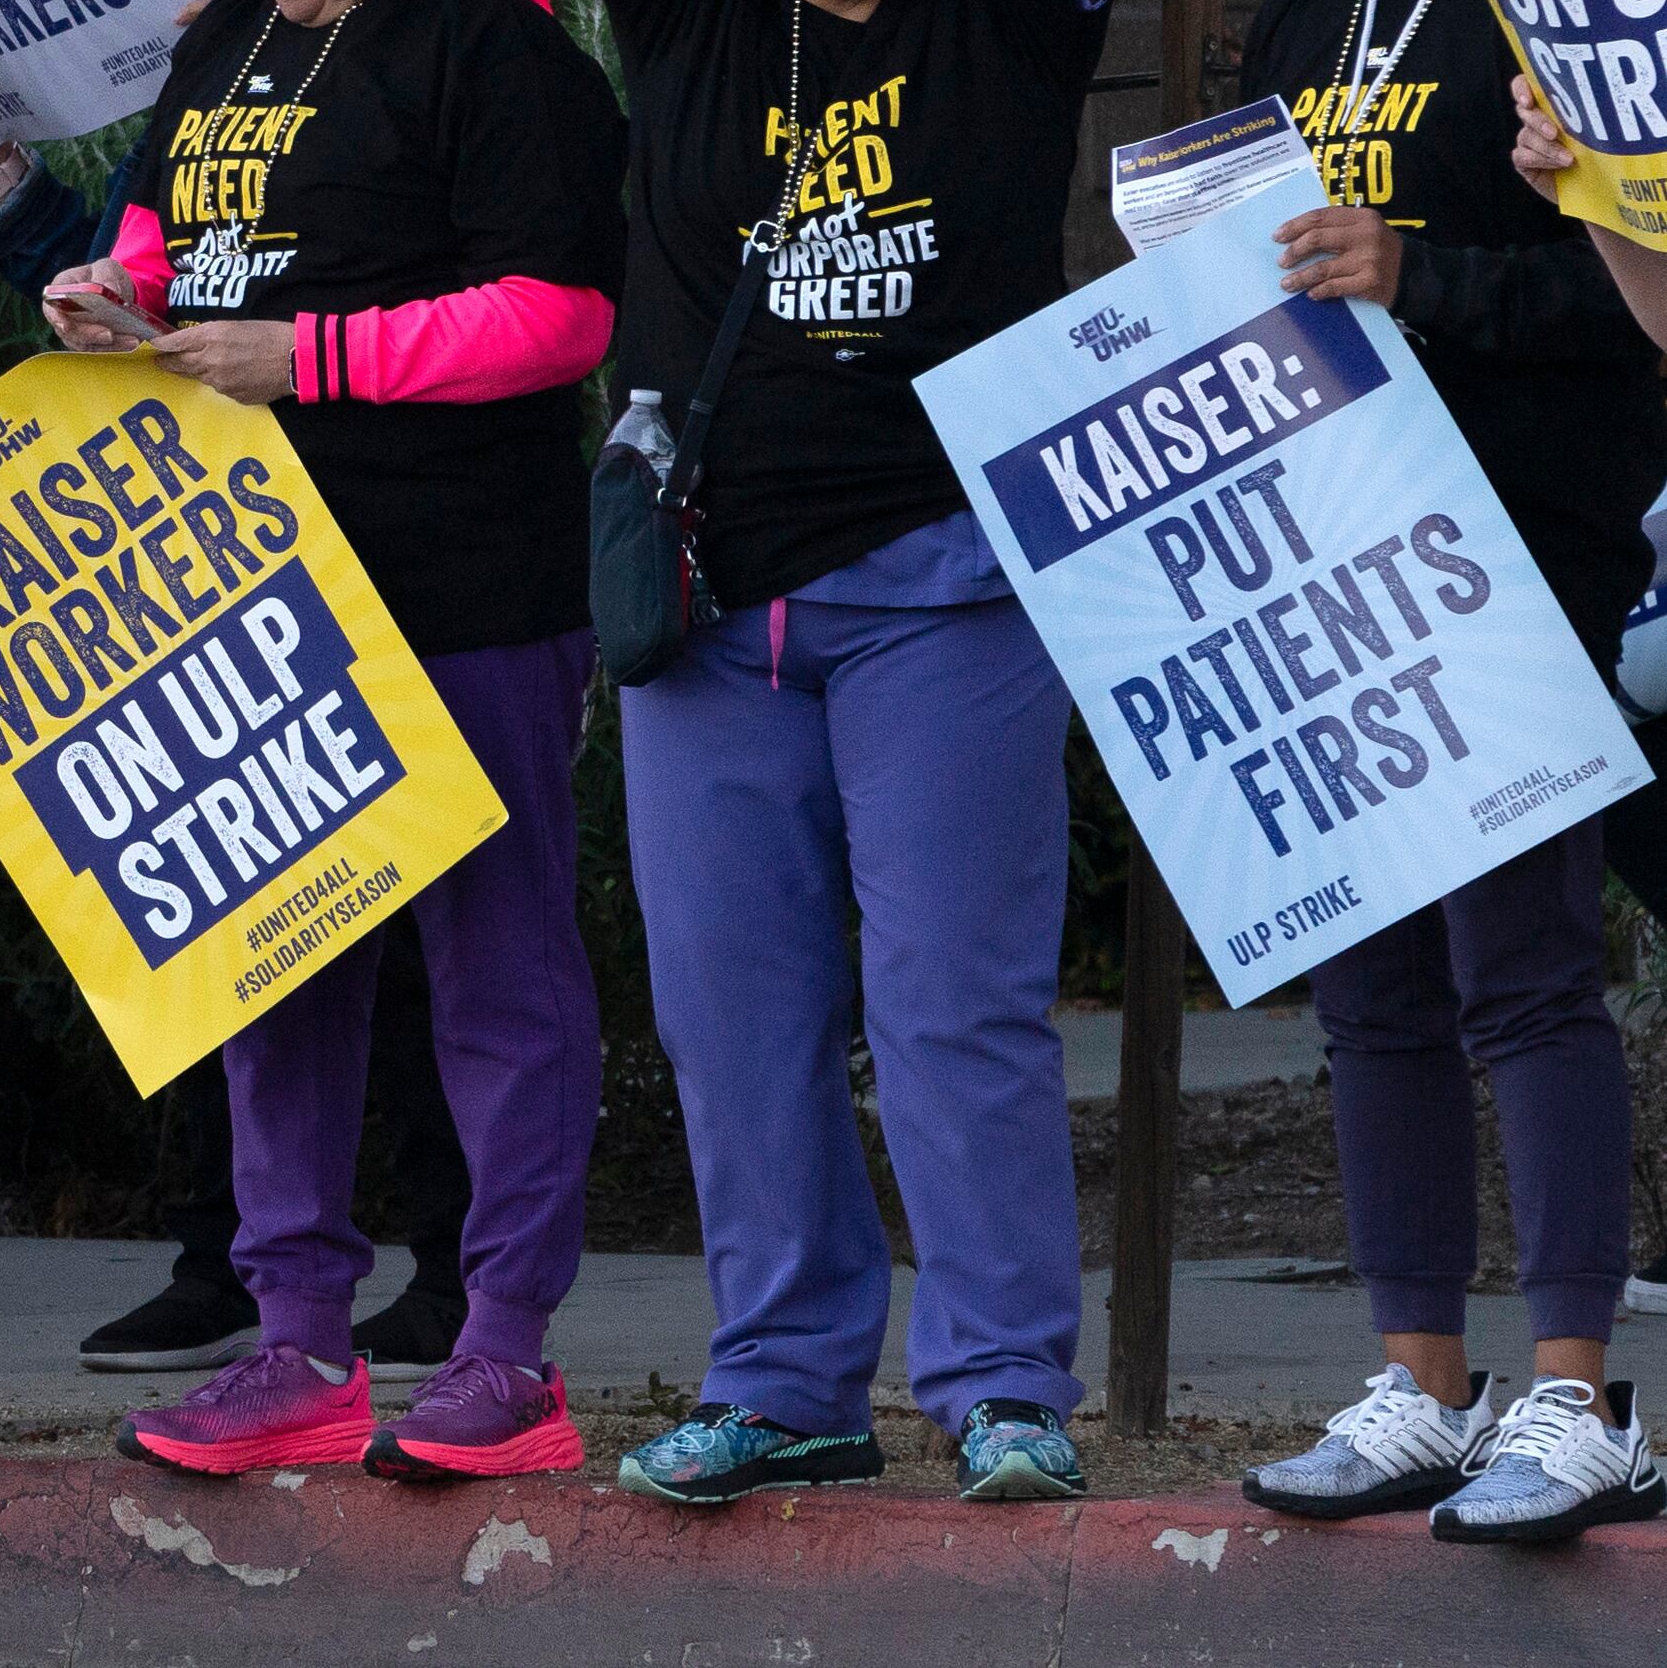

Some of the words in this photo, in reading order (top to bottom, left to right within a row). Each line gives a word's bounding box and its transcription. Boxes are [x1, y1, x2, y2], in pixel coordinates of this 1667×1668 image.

[101, 36, 169, 75] #UNITED4ALL
[110, 50, 173, 88] #SOLIDARITY
[1529, 27, 1667, 141] STR
[169, 104, 317, 158] PATIENT
[1138, 155, 1157, 168] Why
[1179, 138, 1213, 156] orkers
[1212, 133, 1231, 144] Are
[1231, 115, 1276, 137] Striking
[172, 159, 267, 224] NEED
[787, 135, 892, 219] EED
[1312, 140, 1393, 205] EED
[799, 192, 865, 243] not
[769, 271, 913, 321] GREED
[1068, 305, 1126, 351] SEIU-
[1093, 316, 1152, 364] UHW
[1039, 340, 1322, 534] KAISER:
[1144, 459, 1314, 622] PUT
[1109, 512, 1492, 782] PATIENTS
[56, 699, 184, 840] ON
[159, 597, 302, 760] ULP
[1230, 655, 1472, 858] FIRST
[118, 690, 385, 940] STRIKE
[1469, 764, 1556, 821] #UNITED4ALL
[1477, 755, 1610, 837] #SOLIDARITYSEASON
[233, 861, 403, 1004] #SOLIDARITYSEASON
[245, 858, 358, 954] #UNITED4ALL
[1227, 918, 1274, 967] ULP
[1274, 875, 1362, 945] STRIKE
